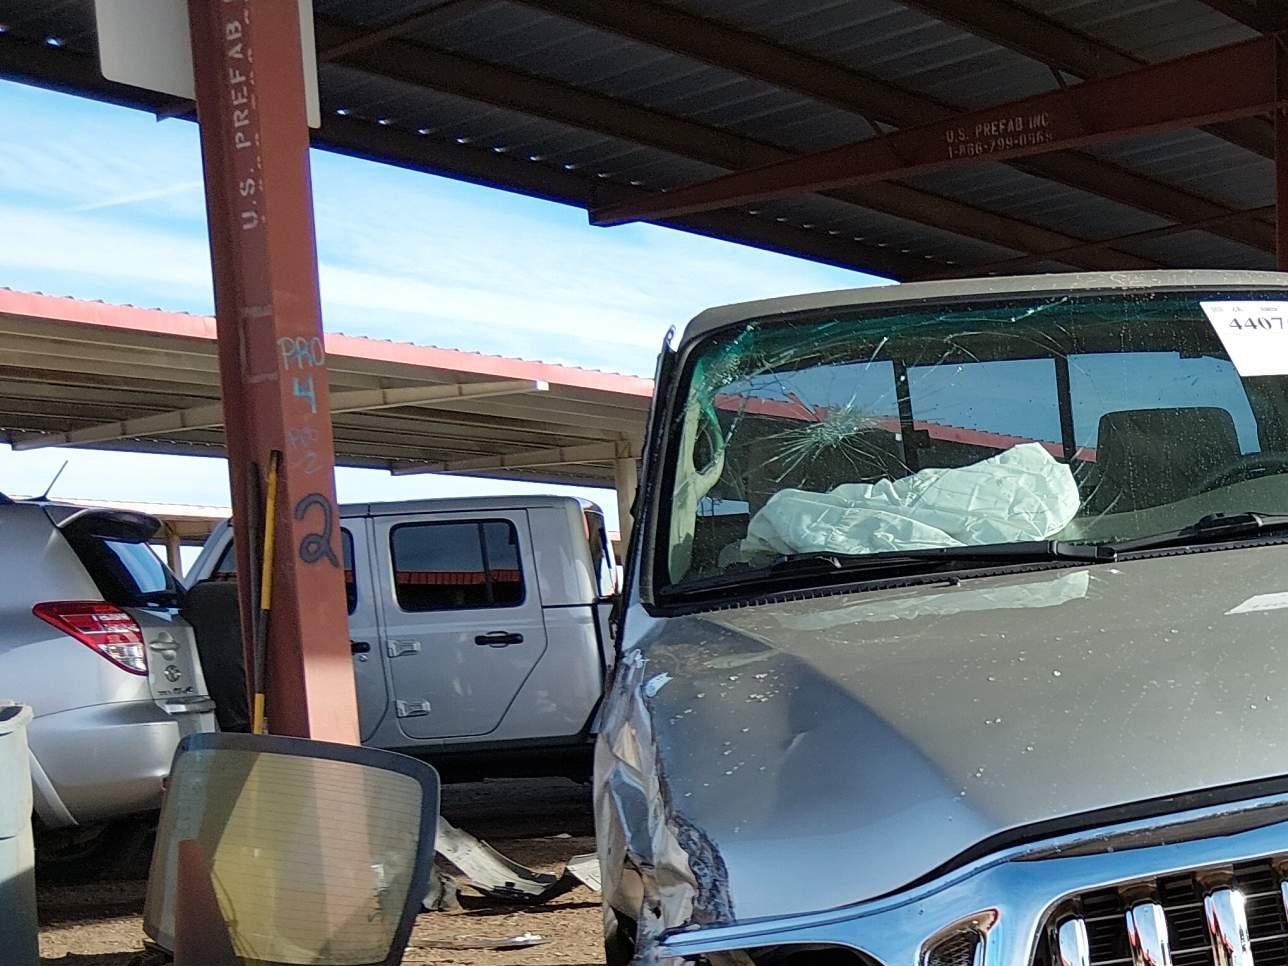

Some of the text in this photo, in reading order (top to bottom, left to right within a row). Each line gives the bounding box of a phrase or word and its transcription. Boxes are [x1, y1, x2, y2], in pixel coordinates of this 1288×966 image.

[226, 20, 252, 149] PREFAB
[946, 128, 969, 143] U.S.
[975, 117, 1024, 138] PREFAB
[239, 168, 259, 230] U.S.
[277, 336, 325, 370] PRO
[292, 375, 317, 414] 4
[295, 493, 340, 568] 2
